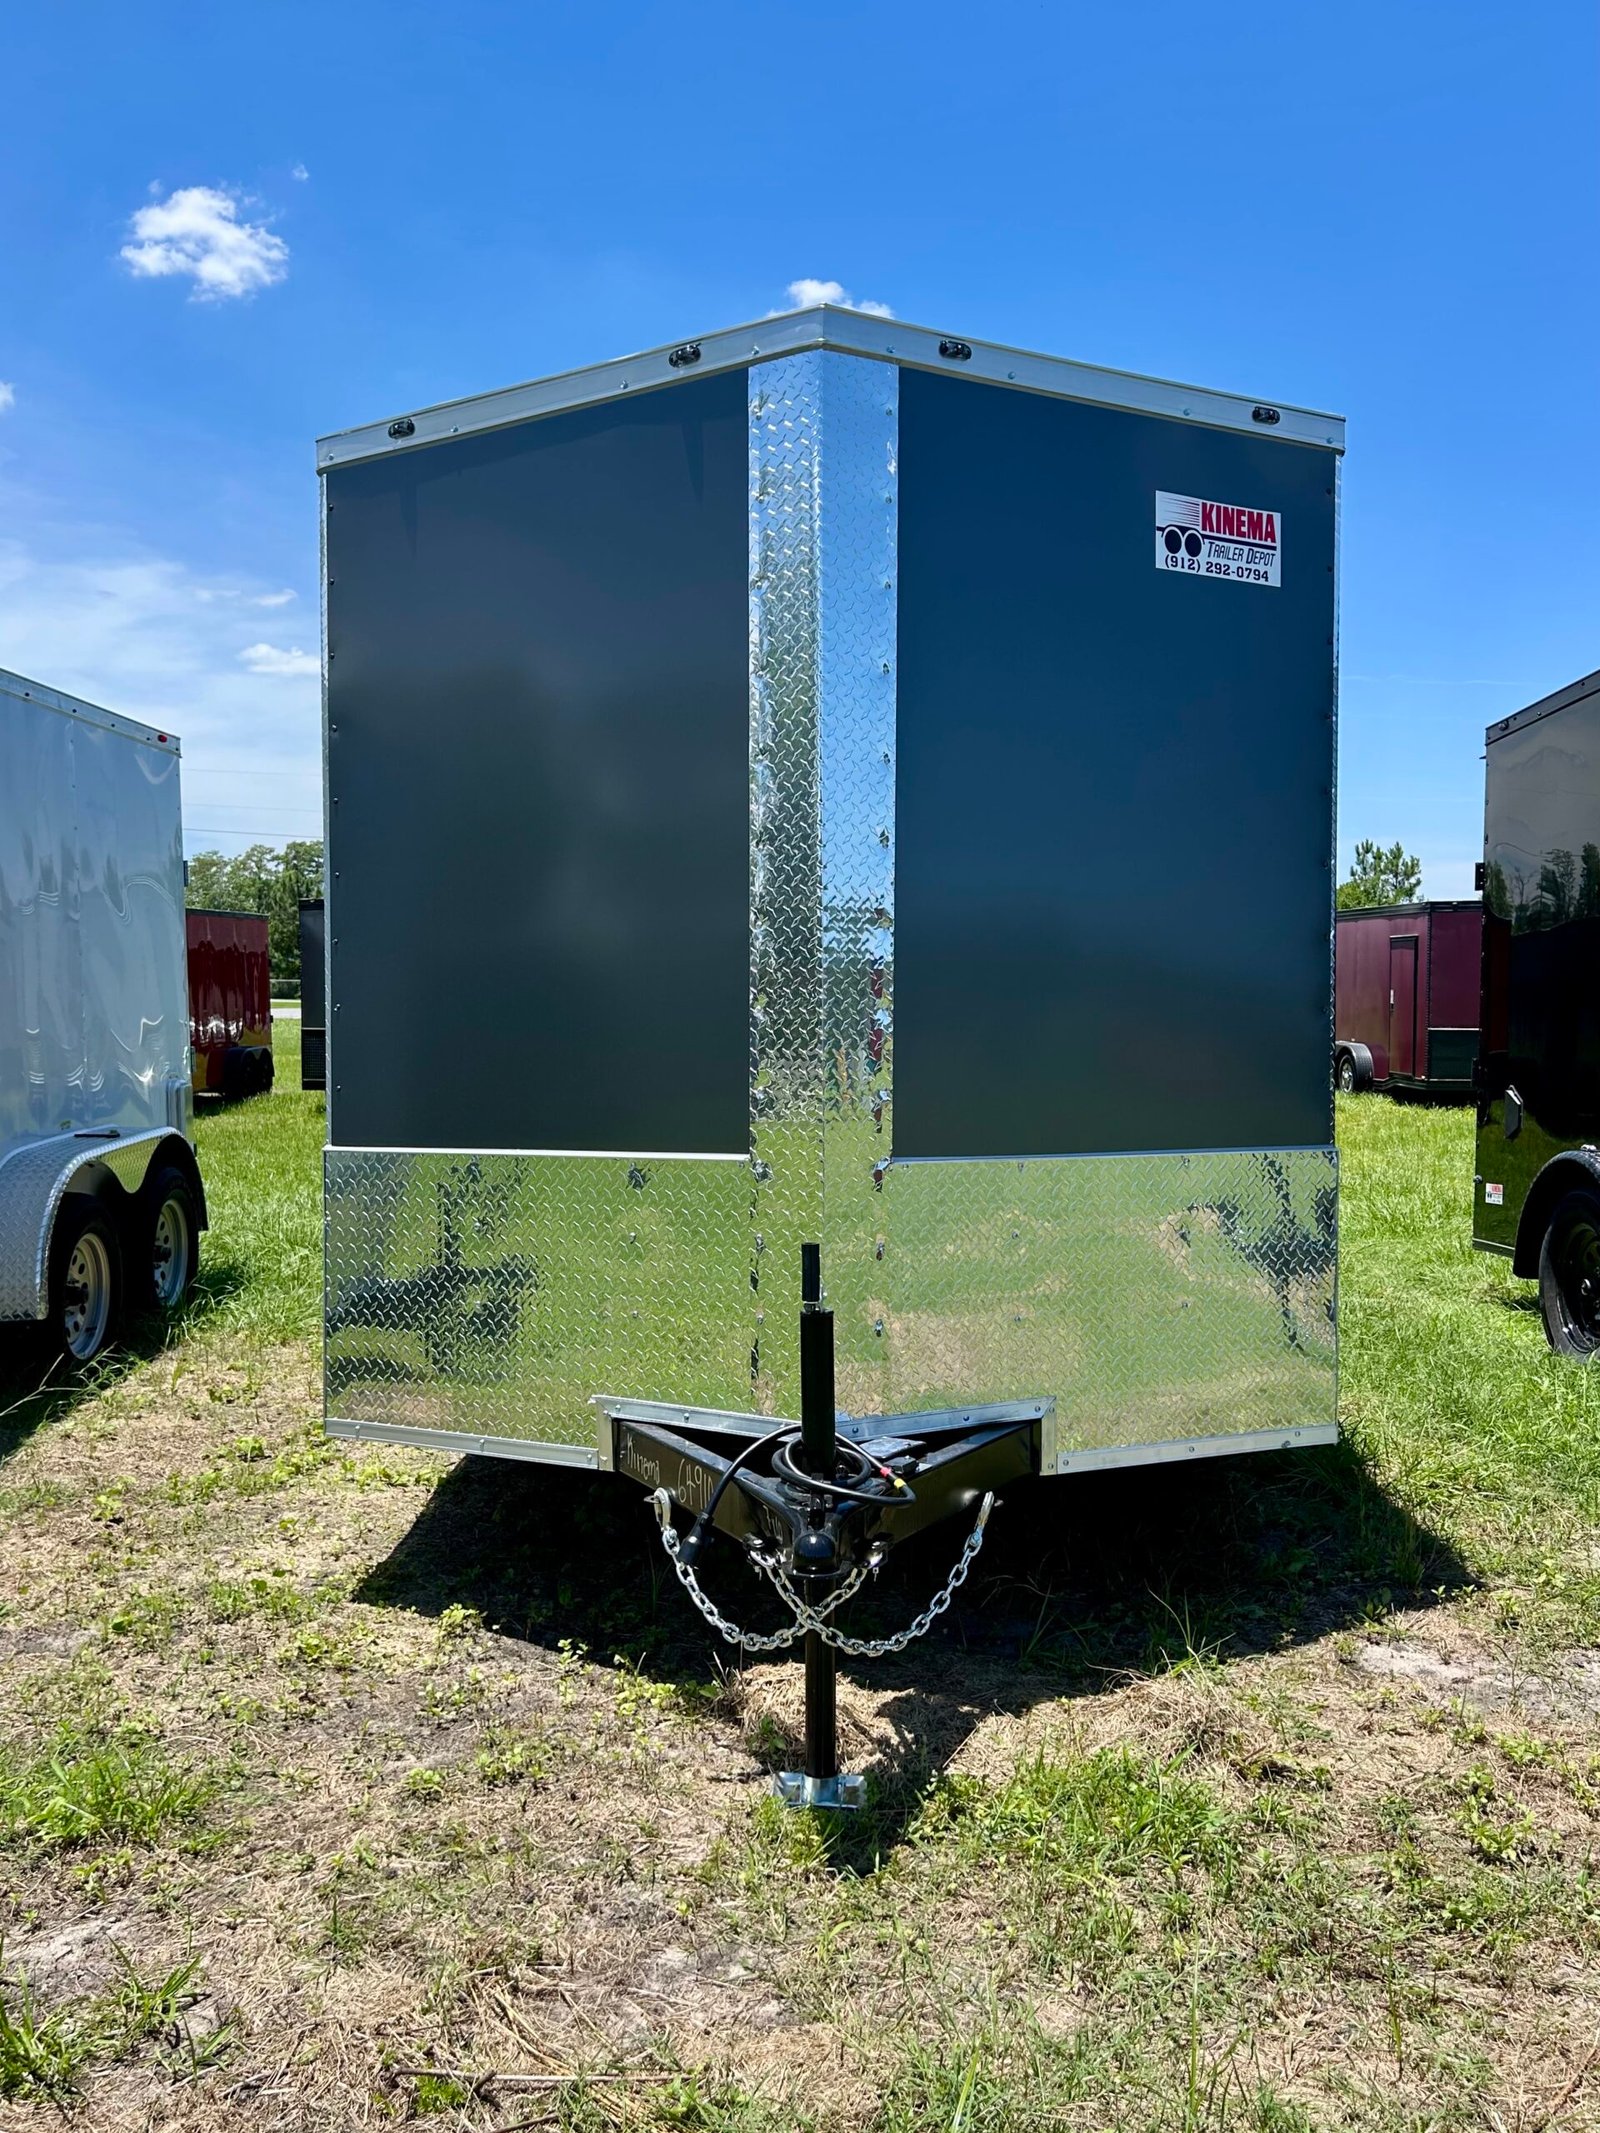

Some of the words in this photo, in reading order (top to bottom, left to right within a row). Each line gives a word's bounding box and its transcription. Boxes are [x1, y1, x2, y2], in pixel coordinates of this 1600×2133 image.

[1201, 501, 1277, 544] KINEMA
[1207, 541, 1245, 562] TRAILER
[1164, 554, 1201, 573] (912)
[1205, 561, 1269, 582] 292-0794
